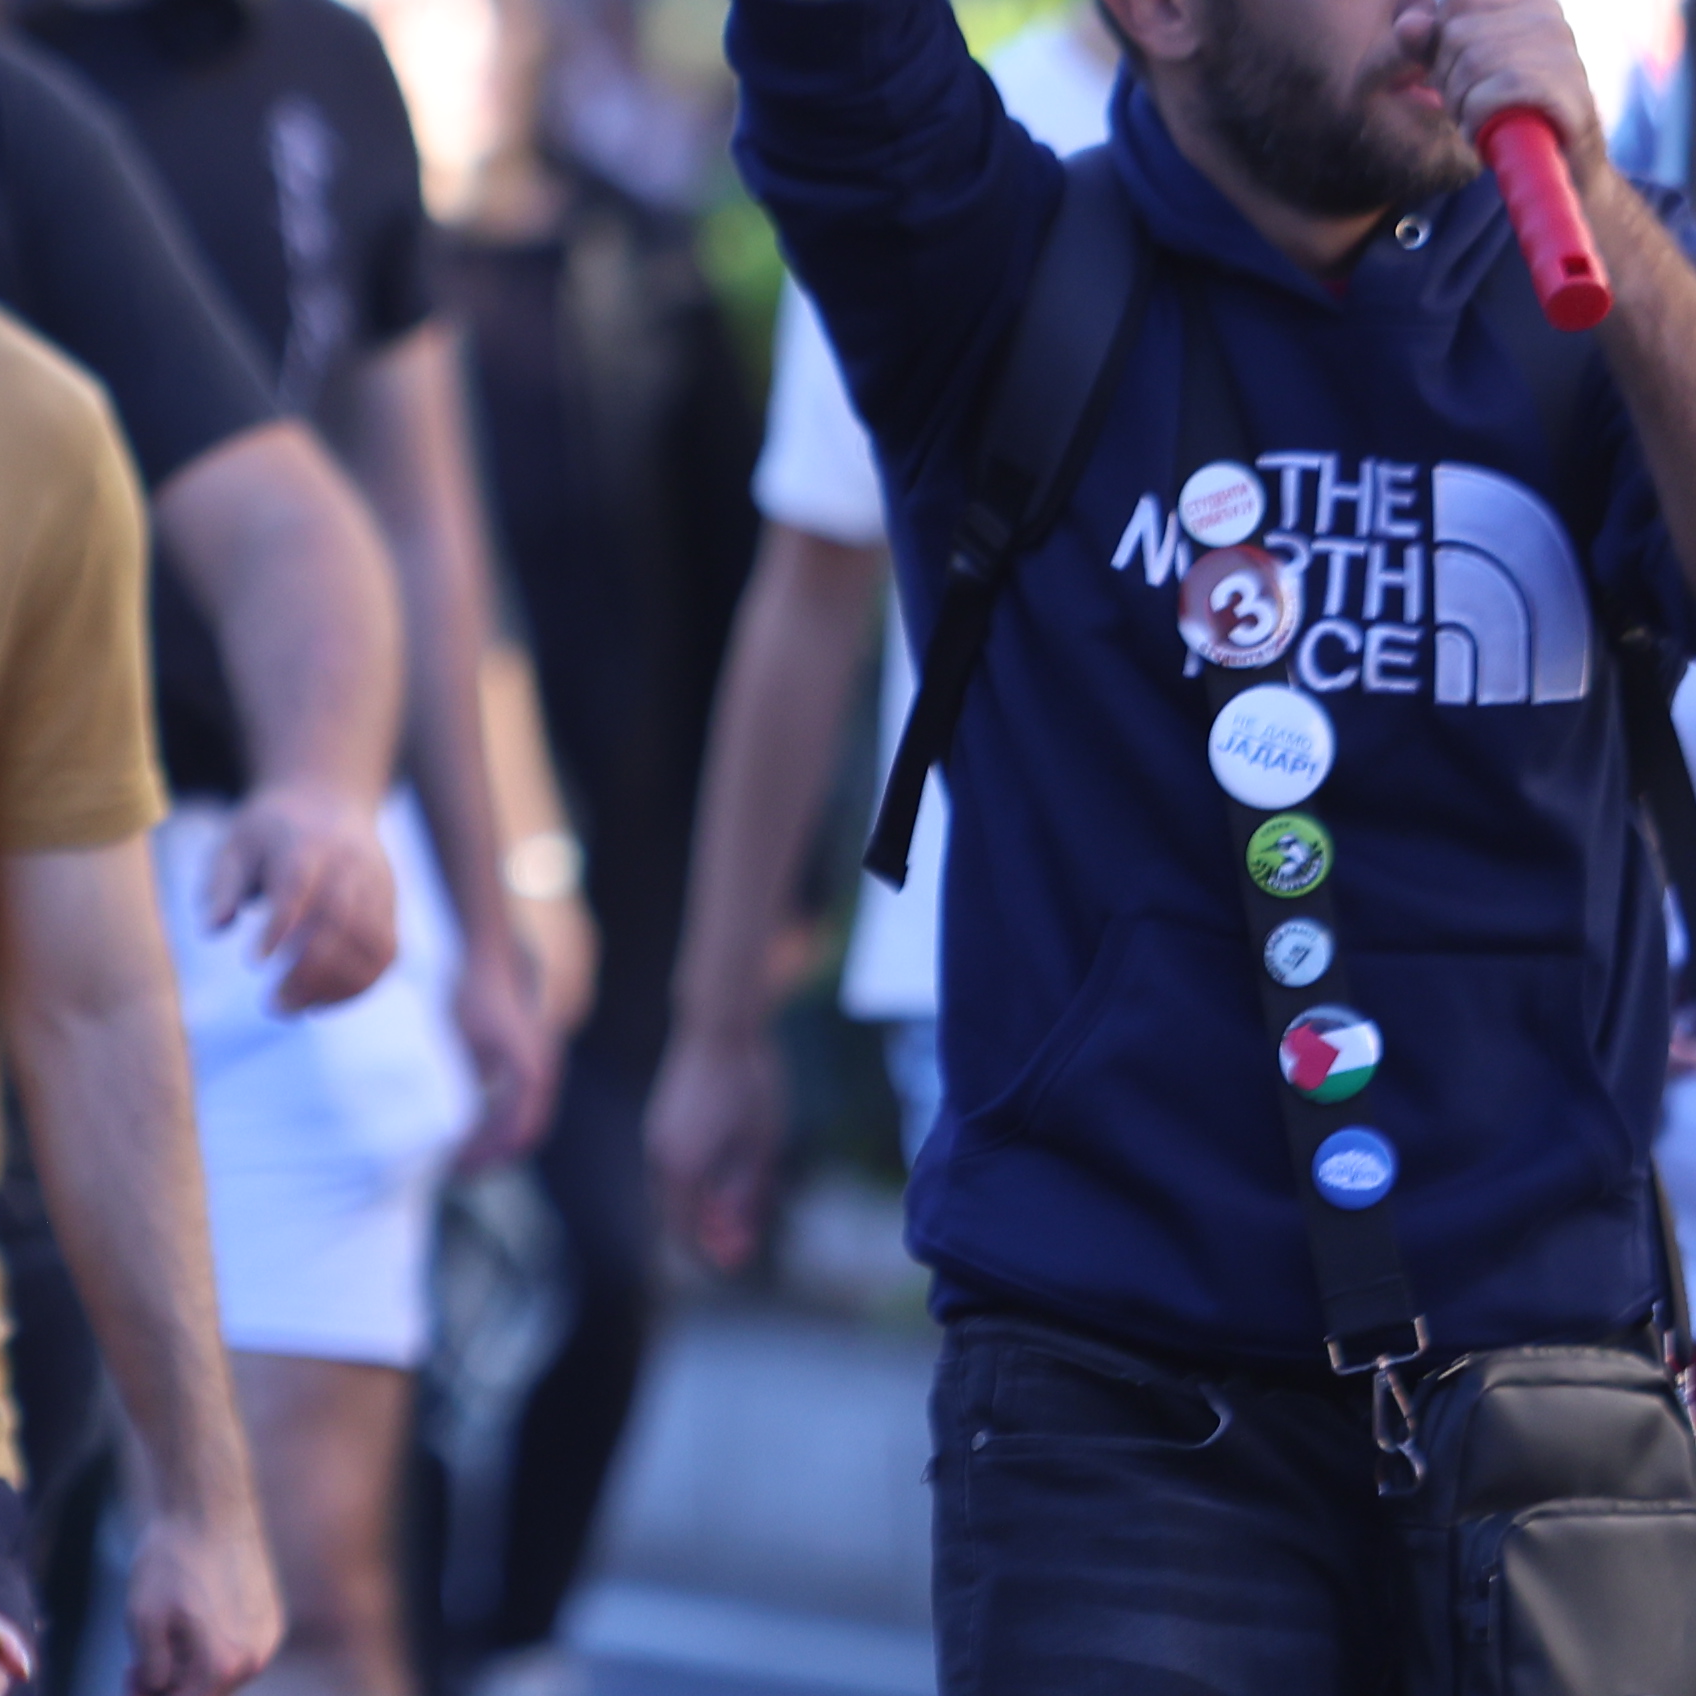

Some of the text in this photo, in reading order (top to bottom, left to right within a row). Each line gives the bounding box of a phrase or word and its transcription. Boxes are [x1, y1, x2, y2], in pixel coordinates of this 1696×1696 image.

[1254, 451, 1423, 540] THE
[1110, 493, 1427, 624] NTH
[1210, 569, 1279, 647] 3
[1183, 618, 1425, 695] CE
